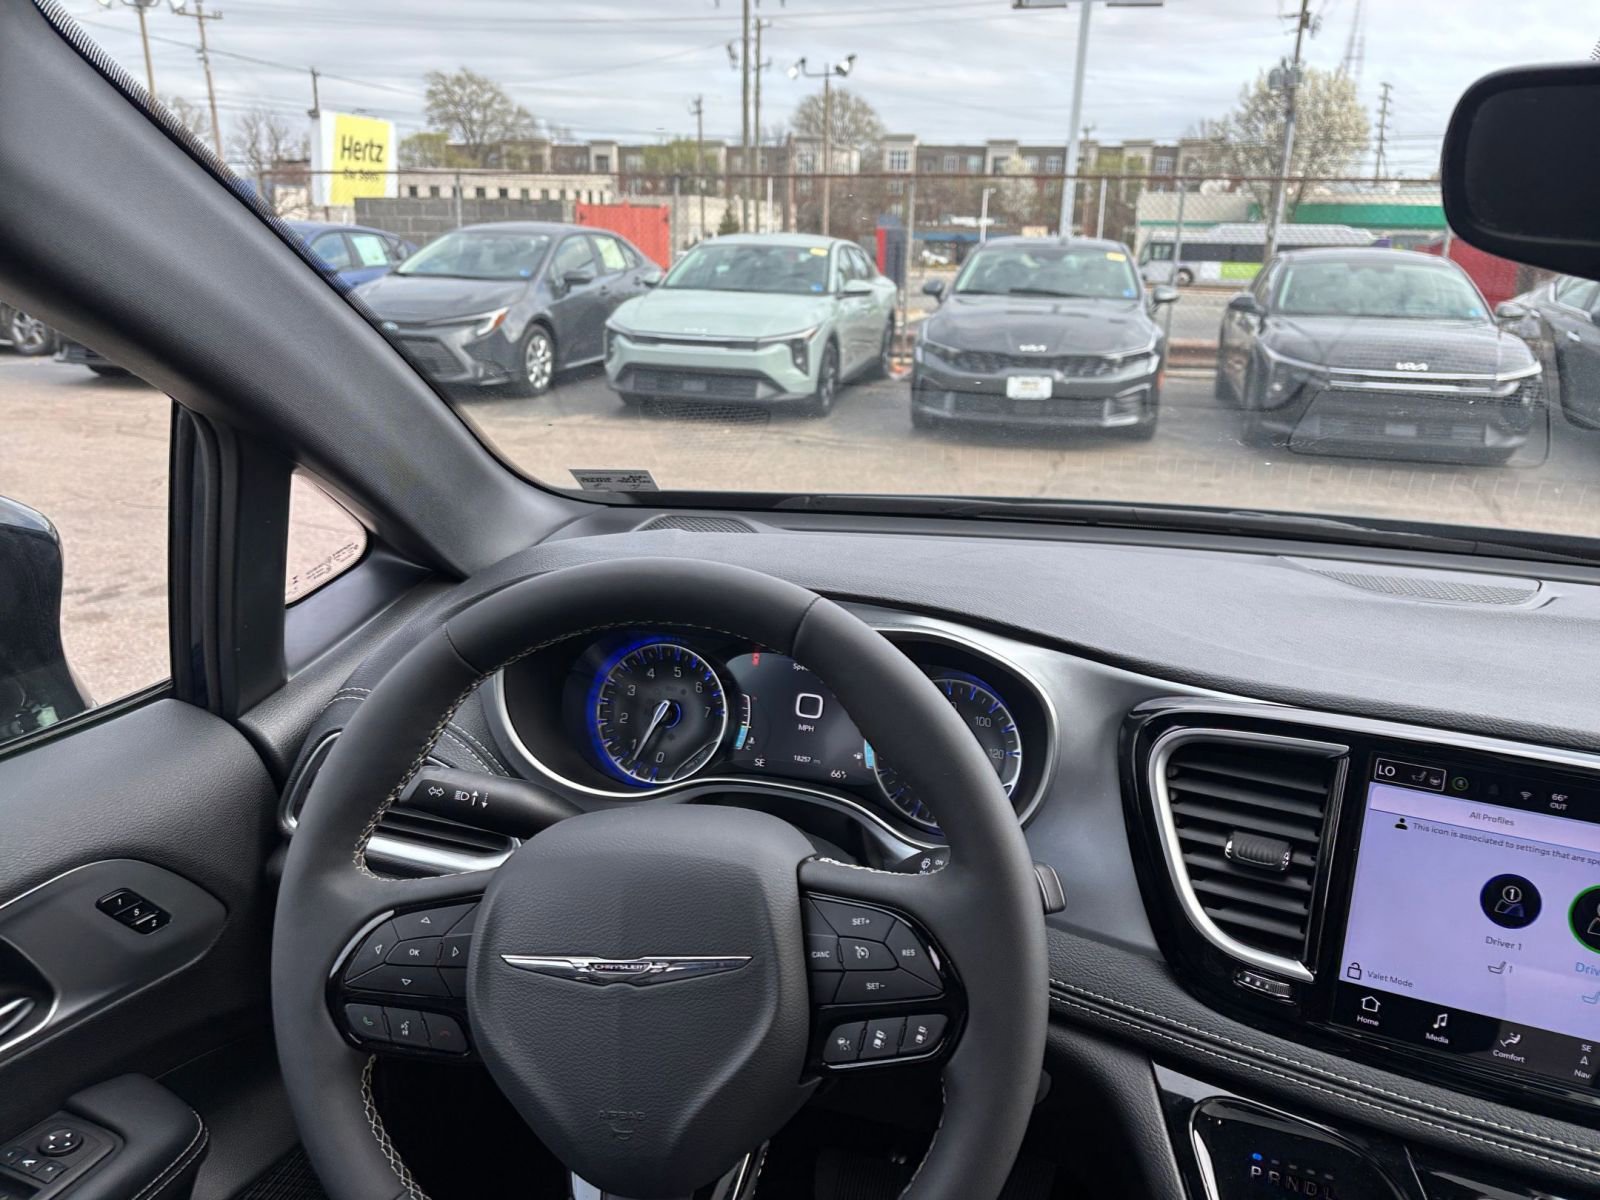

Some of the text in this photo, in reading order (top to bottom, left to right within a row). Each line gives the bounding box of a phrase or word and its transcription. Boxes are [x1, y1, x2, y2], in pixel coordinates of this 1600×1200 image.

[340, 135, 384, 163] Hertz
[647, 667, 655, 679] 4
[673, 666, 682, 678] 5
[627, 684, 636, 696] 3
[695, 681, 703, 693] 6
[619, 712, 629, 724] 2
[704, 706, 711, 718] 7
[798, 723, 815, 732] MPH
[975, 716, 991, 728] 100
[655, 751, 664, 763] 0
[754, 758, 766, 767] SE
[1378, 764, 1396, 777] LO
[1550, 802, 1567, 811] OUT
[1469, 811, 1515, 827] All Profiles
[1413, 822, 1429, 832] This
[1430, 826, 1449, 836] icon
[1450, 830, 1458, 838] is
[1458, 832, 1504, 848] associated
[1505, 839, 1514, 848] to
[1515, 842, 1550, 857] settings
[1552, 849, 1570, 860] that
[1571, 854, 1585, 863] are
[852, 917, 870, 926] SET+
[1485, 936, 1515, 950] Driver
[409, 948, 420, 956] OK
[902, 949, 916, 957] RES
[594, 963, 648, 971] CHRYSLER
[1367, 970, 1413, 988] Valet Mode
[1356, 1014, 1380, 1027] Home
[1425, 1032, 1449, 1044] Media
[1581, 1043, 1592, 1052] SE
[1492, 1049, 1526, 1064] Comfort
[1574, 1069, 1591, 1079] Nav
[1250, 1165, 1262, 1178] P
[1267, 1170, 1281, 1184] R
[1285, 1176, 1298, 1192] N
[1304, 1181, 1317, 1197] D
